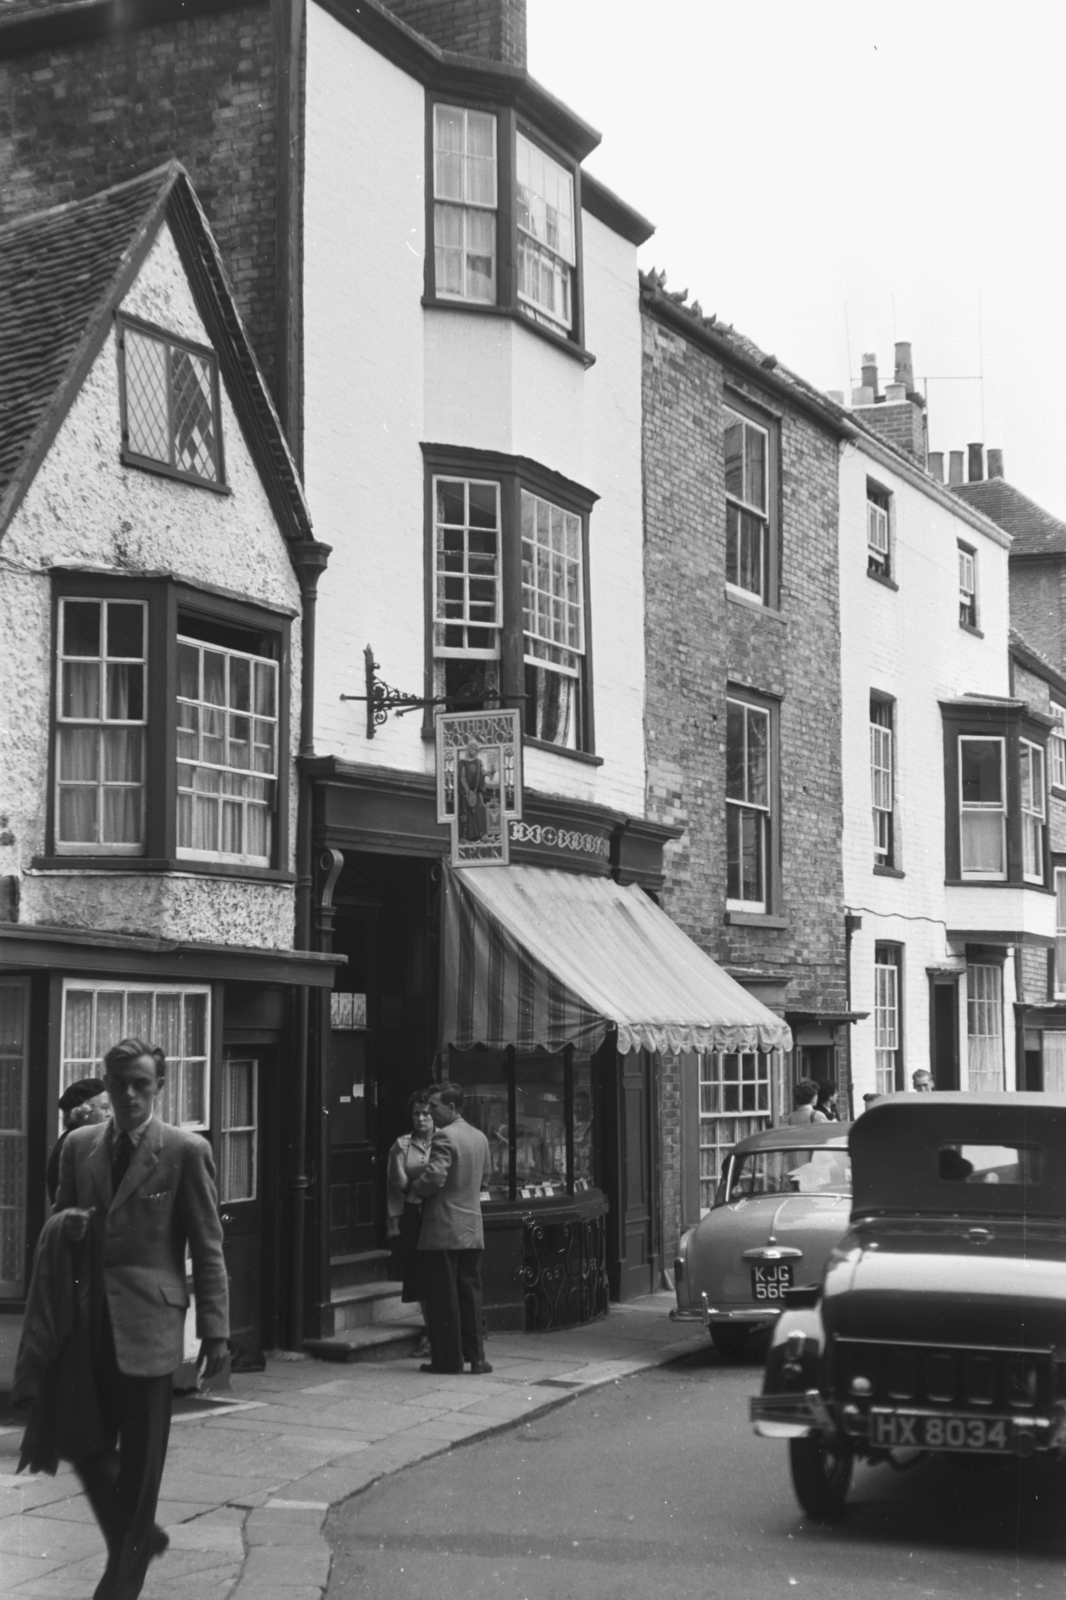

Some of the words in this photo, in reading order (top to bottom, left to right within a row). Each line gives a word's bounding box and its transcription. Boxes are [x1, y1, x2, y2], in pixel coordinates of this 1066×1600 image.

[443, 716, 513, 734] CATHEDRAL
[444, 729, 514, 747] BOOKSHOP
[755, 1266, 790, 1282] KJG
[876, 1416, 917, 1444] HX
[925, 1418, 1007, 1449] 8034
